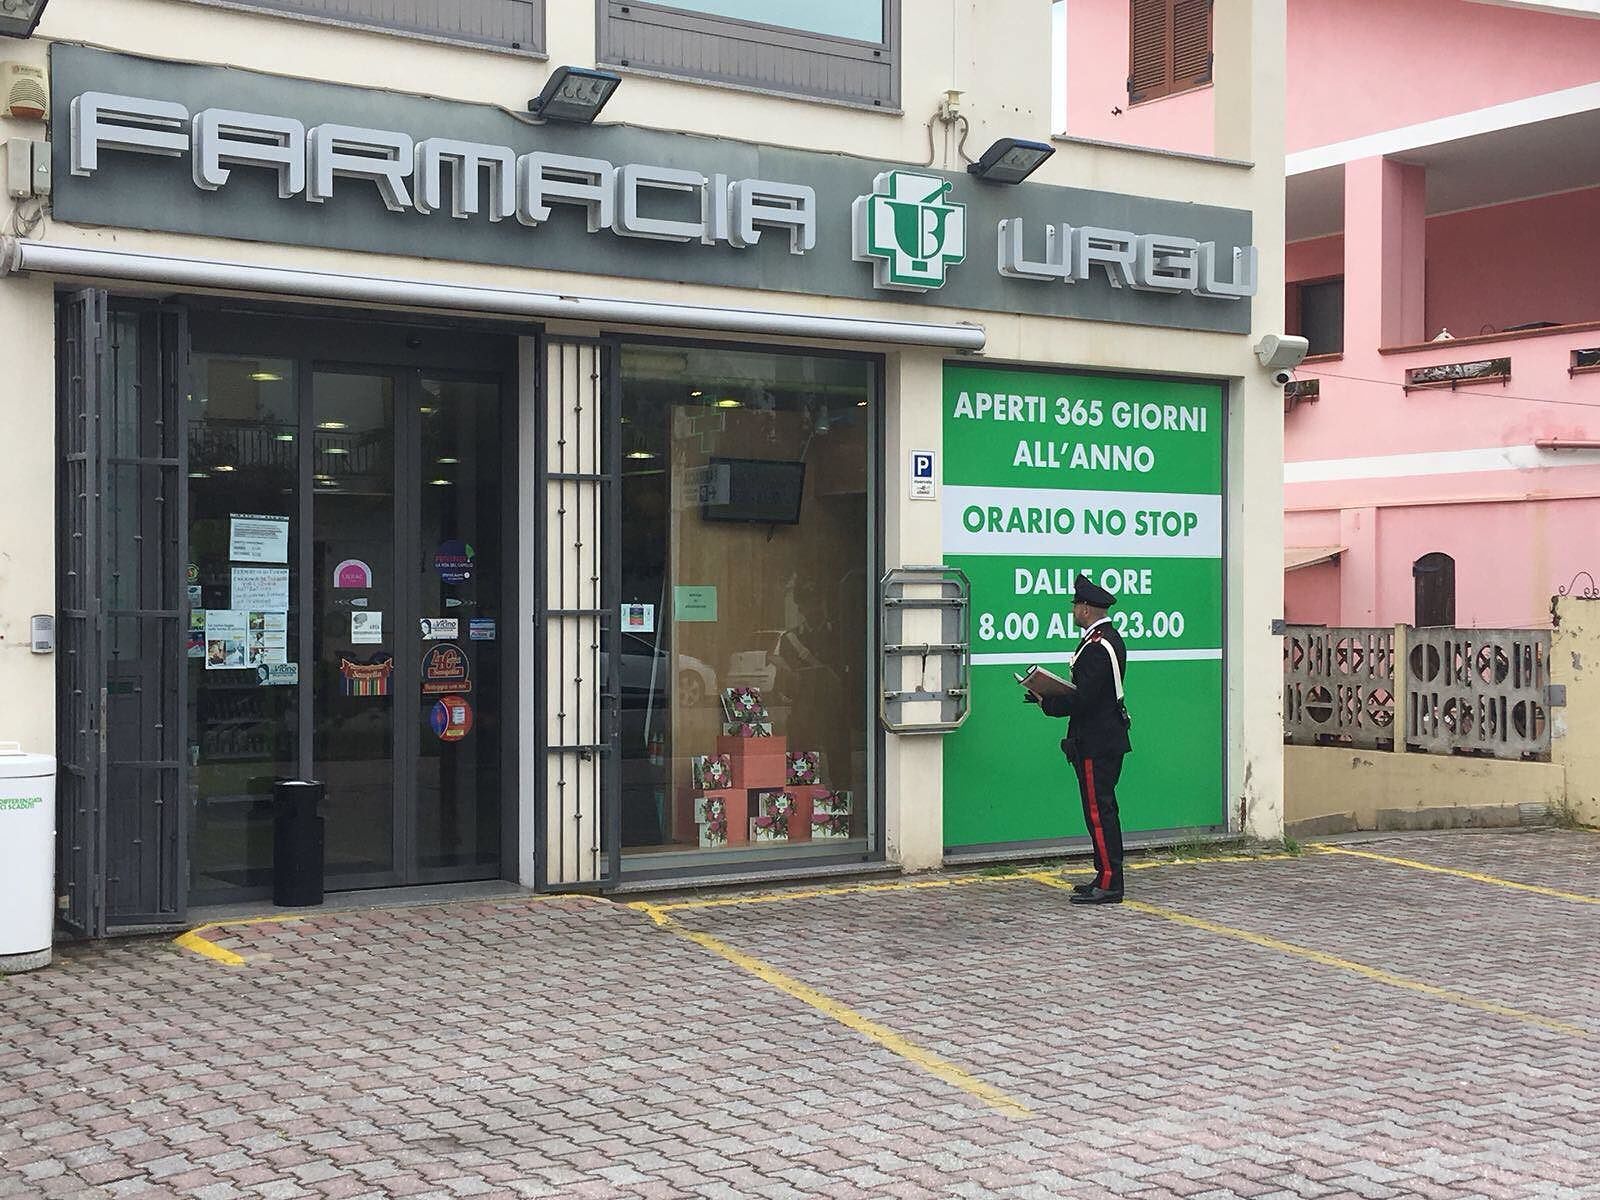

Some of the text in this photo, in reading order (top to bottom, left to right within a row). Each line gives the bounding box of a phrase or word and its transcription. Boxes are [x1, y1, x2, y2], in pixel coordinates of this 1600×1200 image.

[71, 91, 817, 254] FARMACIA
[998, 217, 1259, 299] URGU
[953, 391, 1208, 432] APERTI 365 GIORNI
[1012, 440, 1155, 473] ALL'ANNO
[962, 505, 1199, 537] ORARIO NO STOP
[1100, 568, 1153, 595] ORE
[978, 611, 1185, 641] 8.00 AL 23.00
